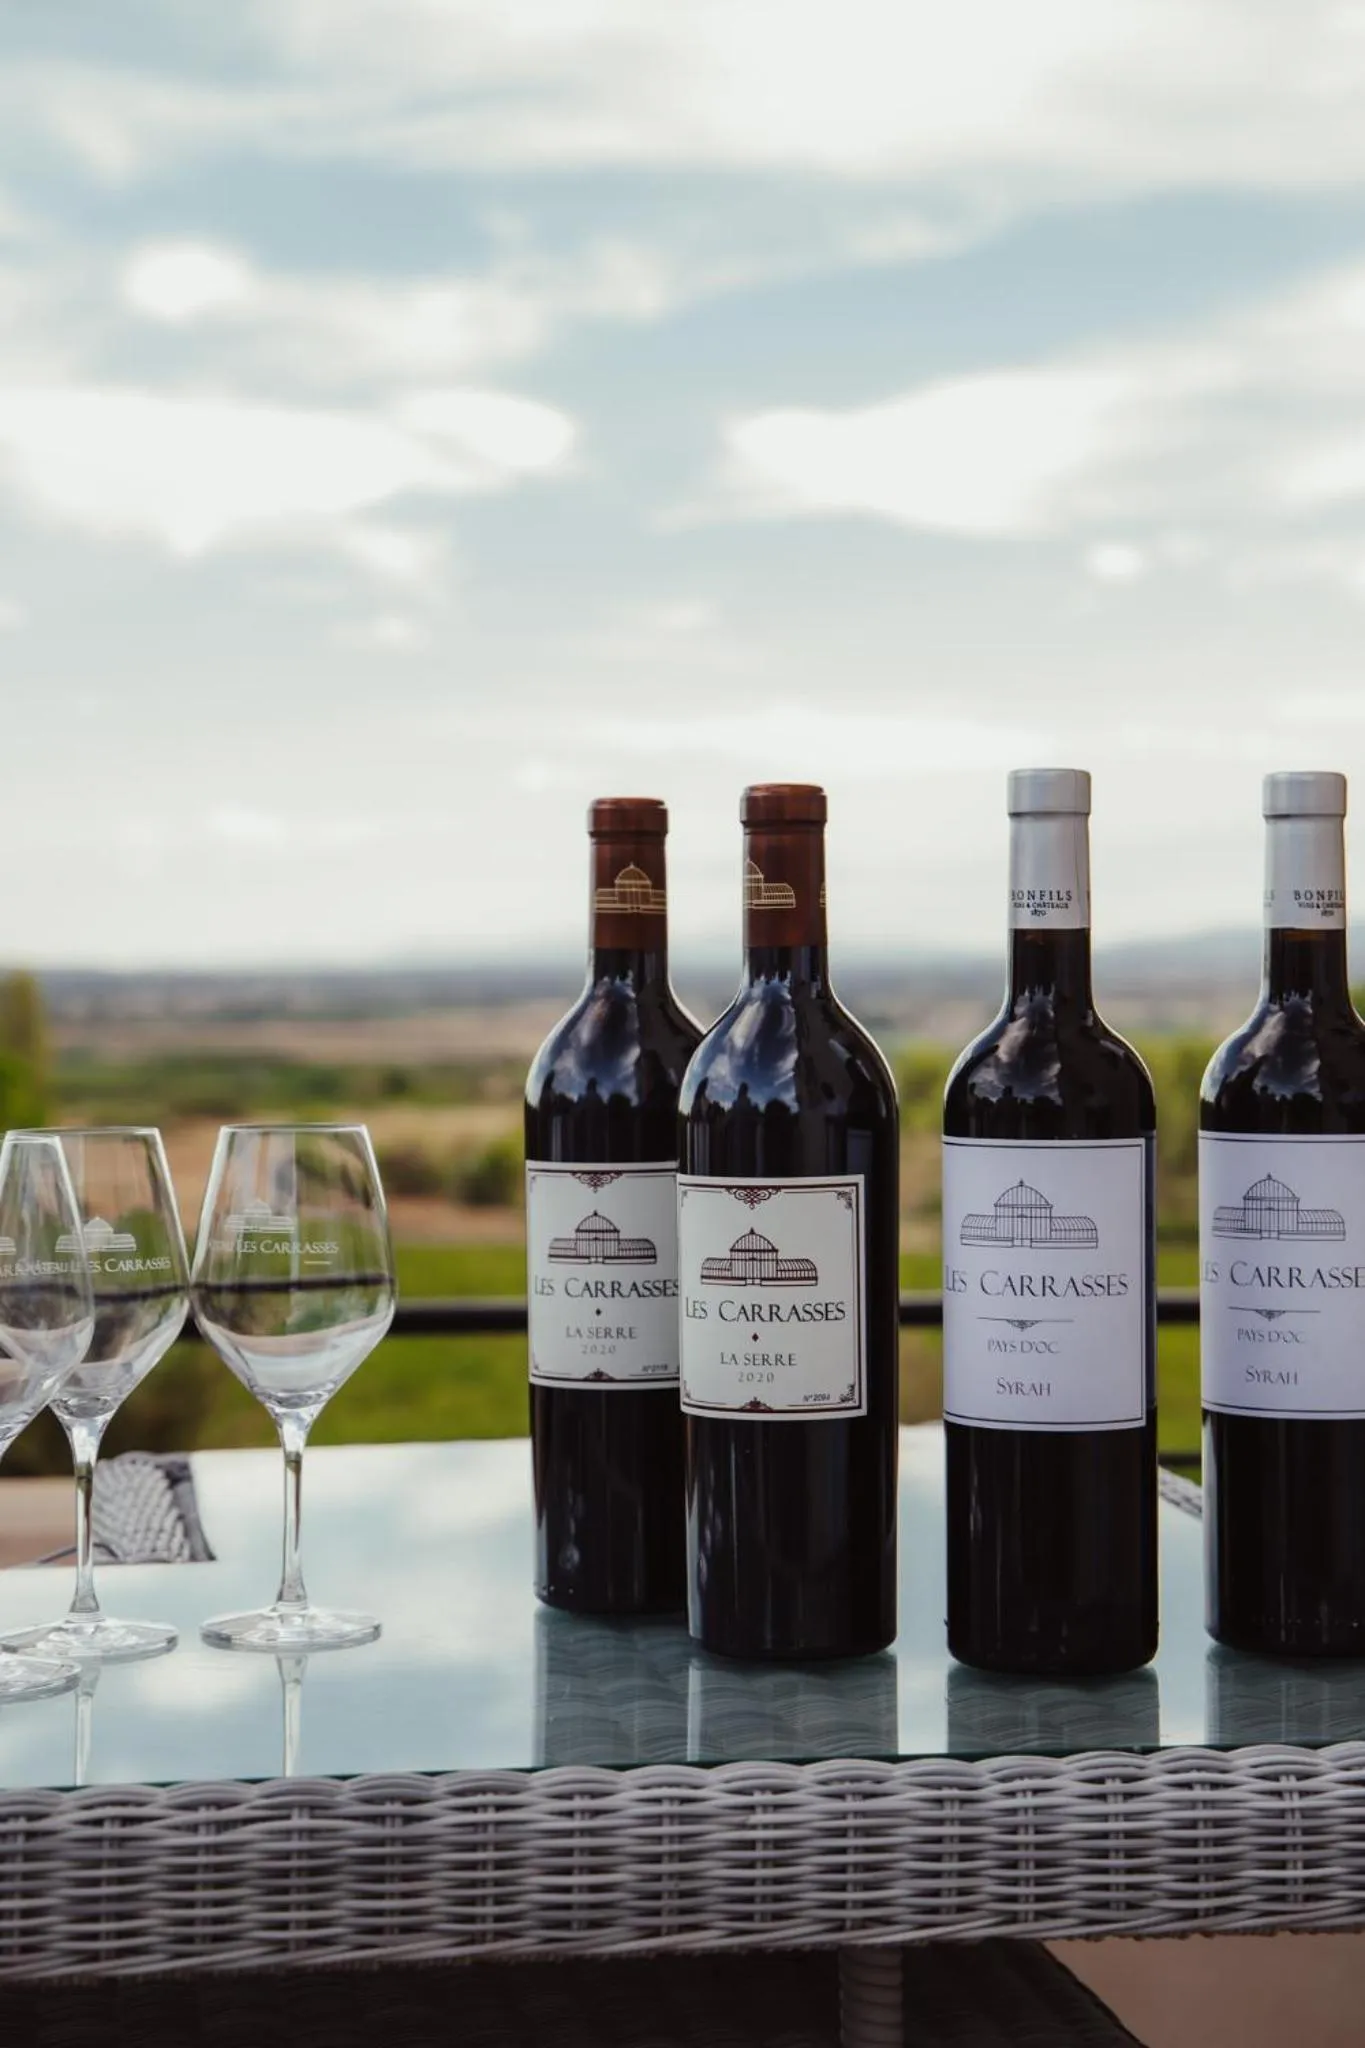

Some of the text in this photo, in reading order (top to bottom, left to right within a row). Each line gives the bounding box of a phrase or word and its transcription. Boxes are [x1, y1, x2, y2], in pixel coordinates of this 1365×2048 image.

[1294, 889, 1346, 901] BONFIL
[260, 1239, 339, 1254] CARRASSES
[104, 1257, 171, 1273] CARRASSES
[944, 1265, 1129, 1298] LES CARRASSES
[1230, 1260, 1365, 1289] CARRASSE
[534, 1274, 679, 1298] LES CARRASSES
[686, 1296, 846, 1322] LES CARRASSES
[565, 1325, 638, 1339] LA SERRE
[1237, 1327, 1265, 1342] PAYS
[581, 1343, 616, 1355] 2020
[988, 1339, 1060, 1354] PAYS D'OC
[720, 1352, 798, 1366] LA SERRE
[738, 1371, 774, 1383] 2020
[1245, 1365, 1298, 1385] SYRAH
[996, 1376, 1051, 1397] SYRAH
